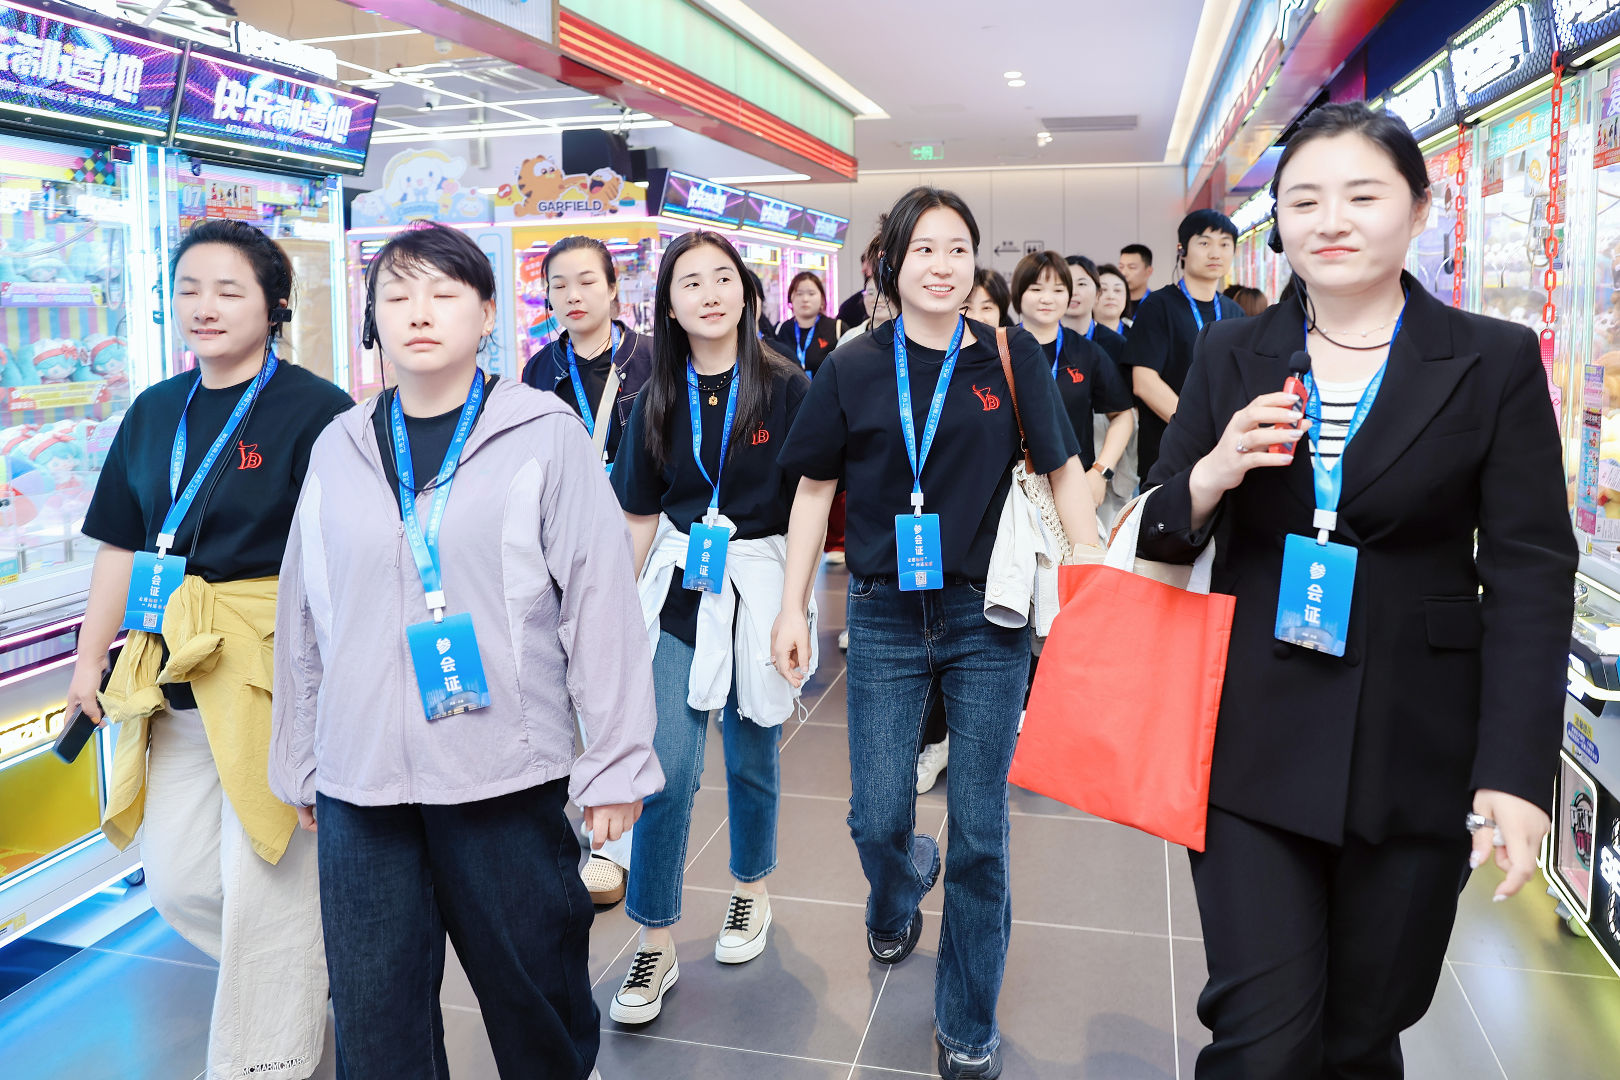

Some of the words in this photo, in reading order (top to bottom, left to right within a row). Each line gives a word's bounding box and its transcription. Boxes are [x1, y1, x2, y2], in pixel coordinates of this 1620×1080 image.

[538, 200, 602, 212] GARFIELD
[700, 538, 712, 576] 参会证
[913, 524, 924, 555] 参会证
[150, 564, 163, 596] 参会证
[1304, 562, 1326, 624] 参会证
[436, 637, 462, 692] 参会证
